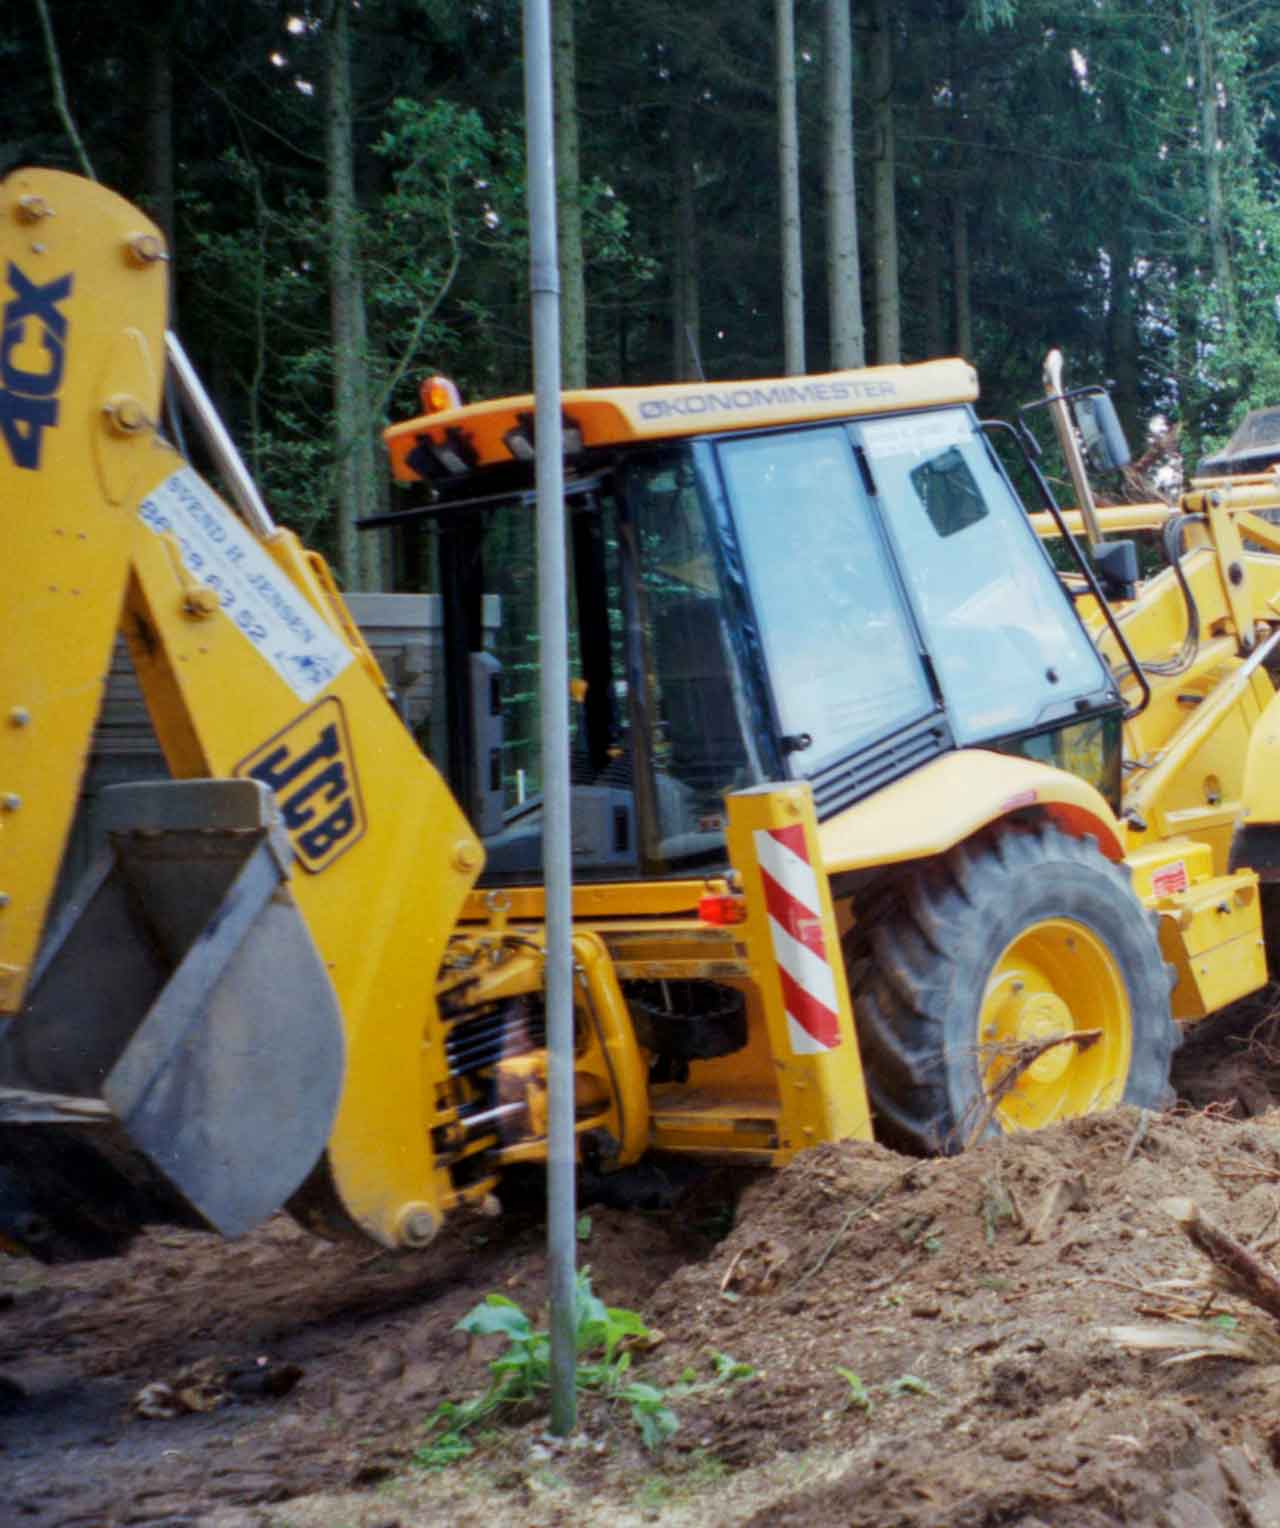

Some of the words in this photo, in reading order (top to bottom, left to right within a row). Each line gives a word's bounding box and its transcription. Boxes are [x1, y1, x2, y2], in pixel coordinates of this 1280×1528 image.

[0, 260, 74, 470] 4CX
[638, 380, 897, 421] ØKONOMIMESTER
[165, 476, 227, 543] SVEND
[246, 573, 316, 643] JENSEN
[249, 722, 356, 859] JCB
